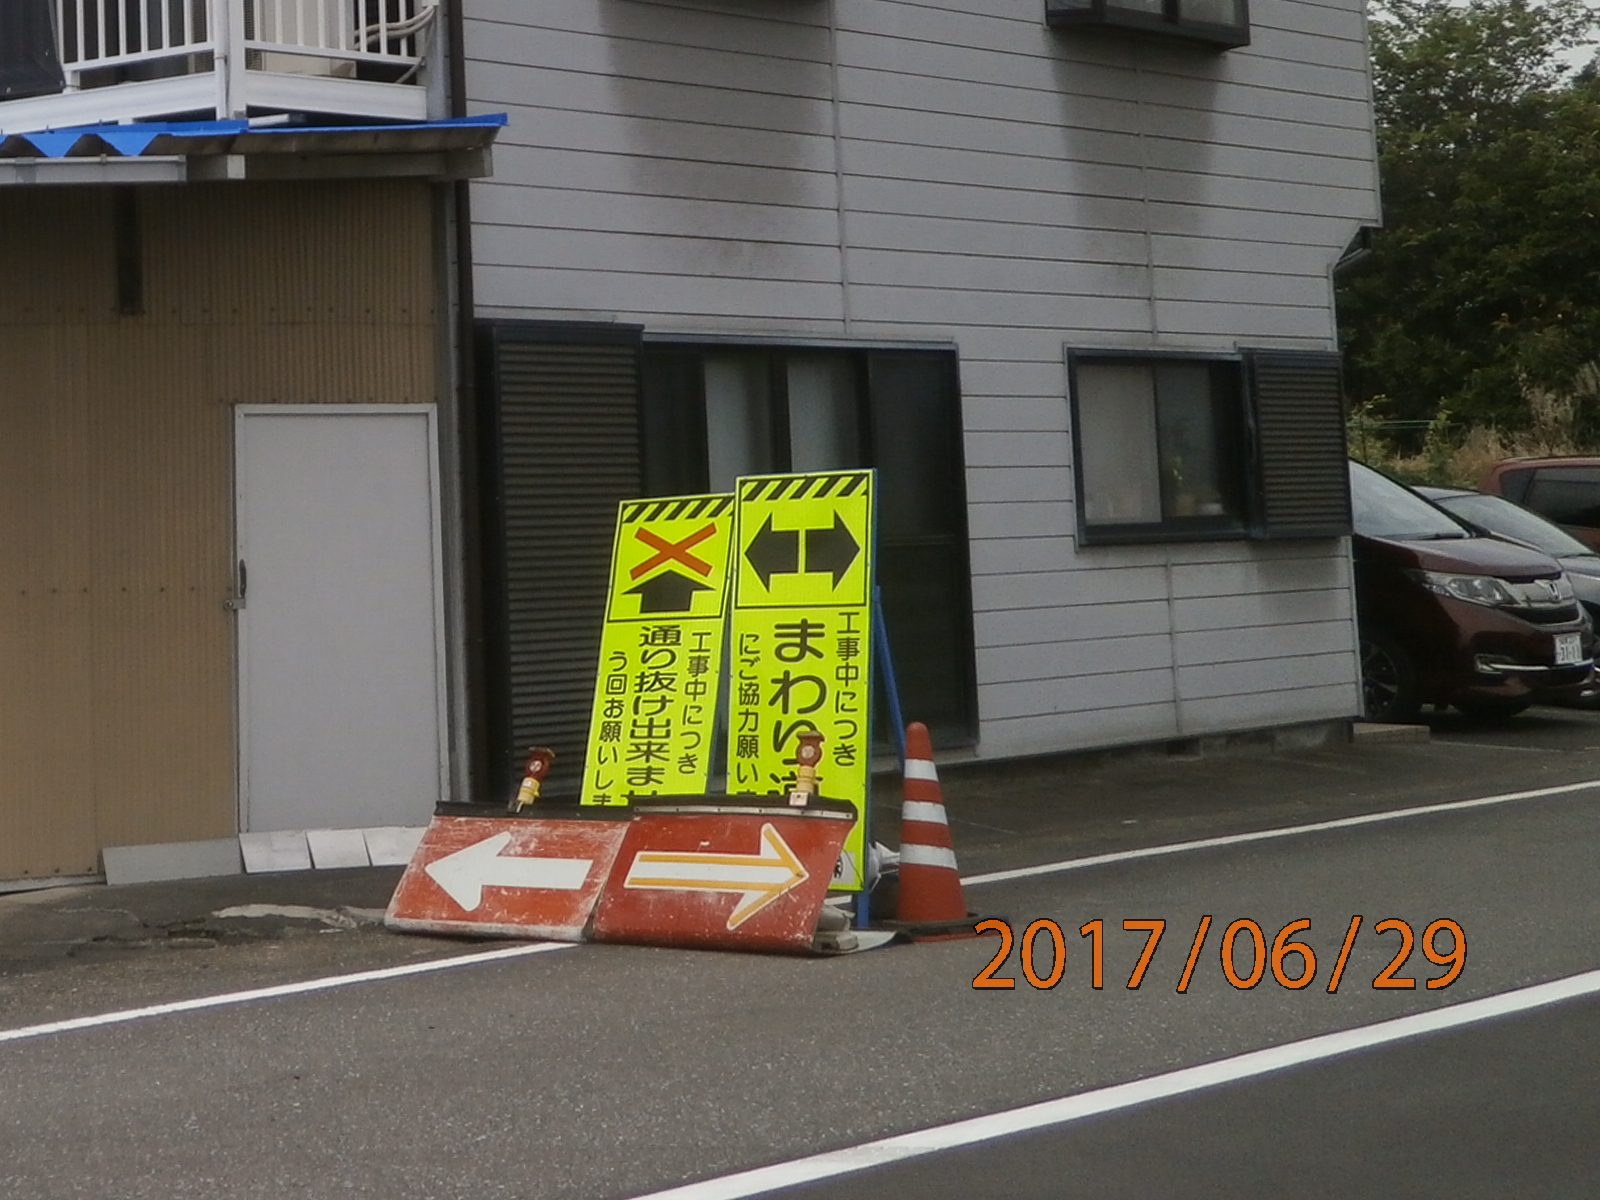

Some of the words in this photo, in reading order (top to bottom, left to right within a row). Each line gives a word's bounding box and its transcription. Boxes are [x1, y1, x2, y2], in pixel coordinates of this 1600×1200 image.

[621, 624, 683, 797] 通り抜け出来ま
[678, 631, 712, 774] 工事中につき
[736, 633, 761, 796] にご協力願い
[833, 611, 861, 767] 工事中につき
